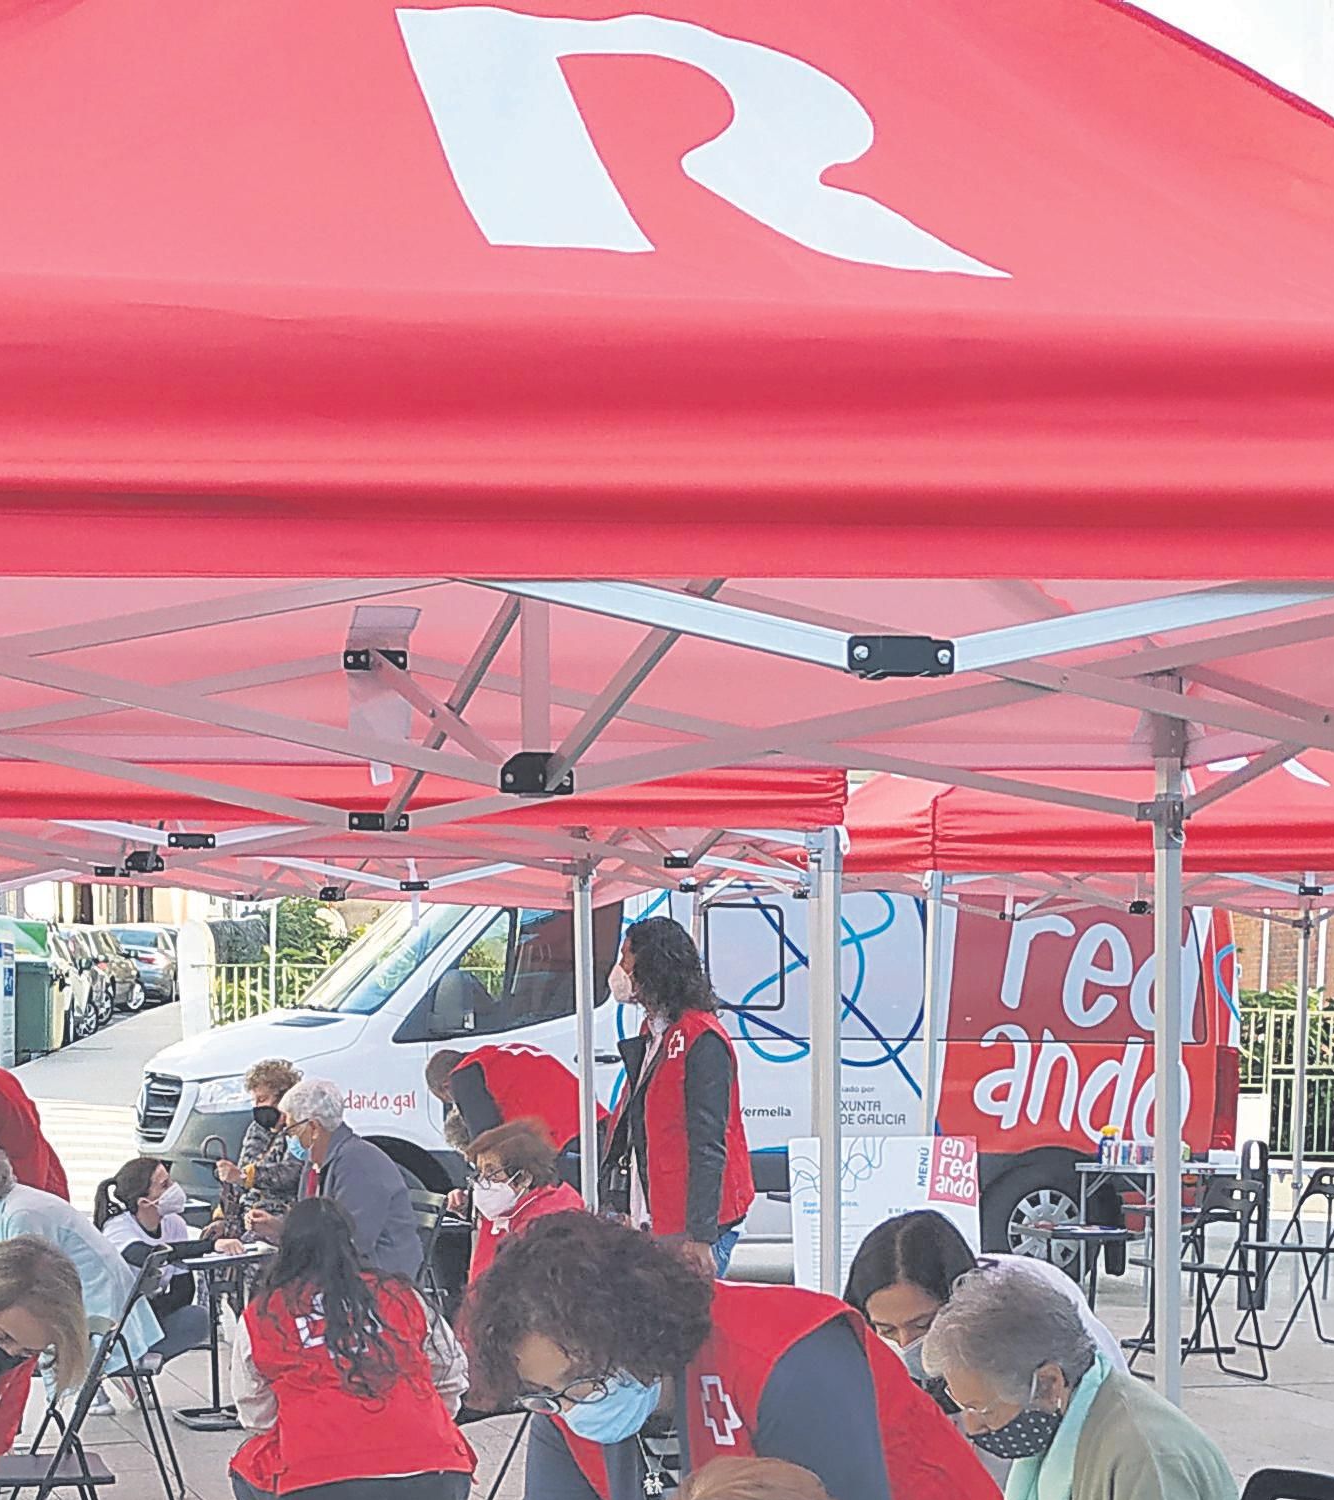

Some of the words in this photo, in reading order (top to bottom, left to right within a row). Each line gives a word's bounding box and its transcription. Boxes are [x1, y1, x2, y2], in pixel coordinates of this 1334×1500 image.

[394, 6, 1013, 279] R
[974, 1024, 1190, 1146] ando
[841, 1100, 881, 1112] XUNTA
[857, 1113, 906, 1126] GALICIA
[941, 1137, 965, 1158] en
[917, 1146, 930, 1187] MENÚ
[938, 1155, 977, 1178] red
[934, 1176, 974, 1199] ando
